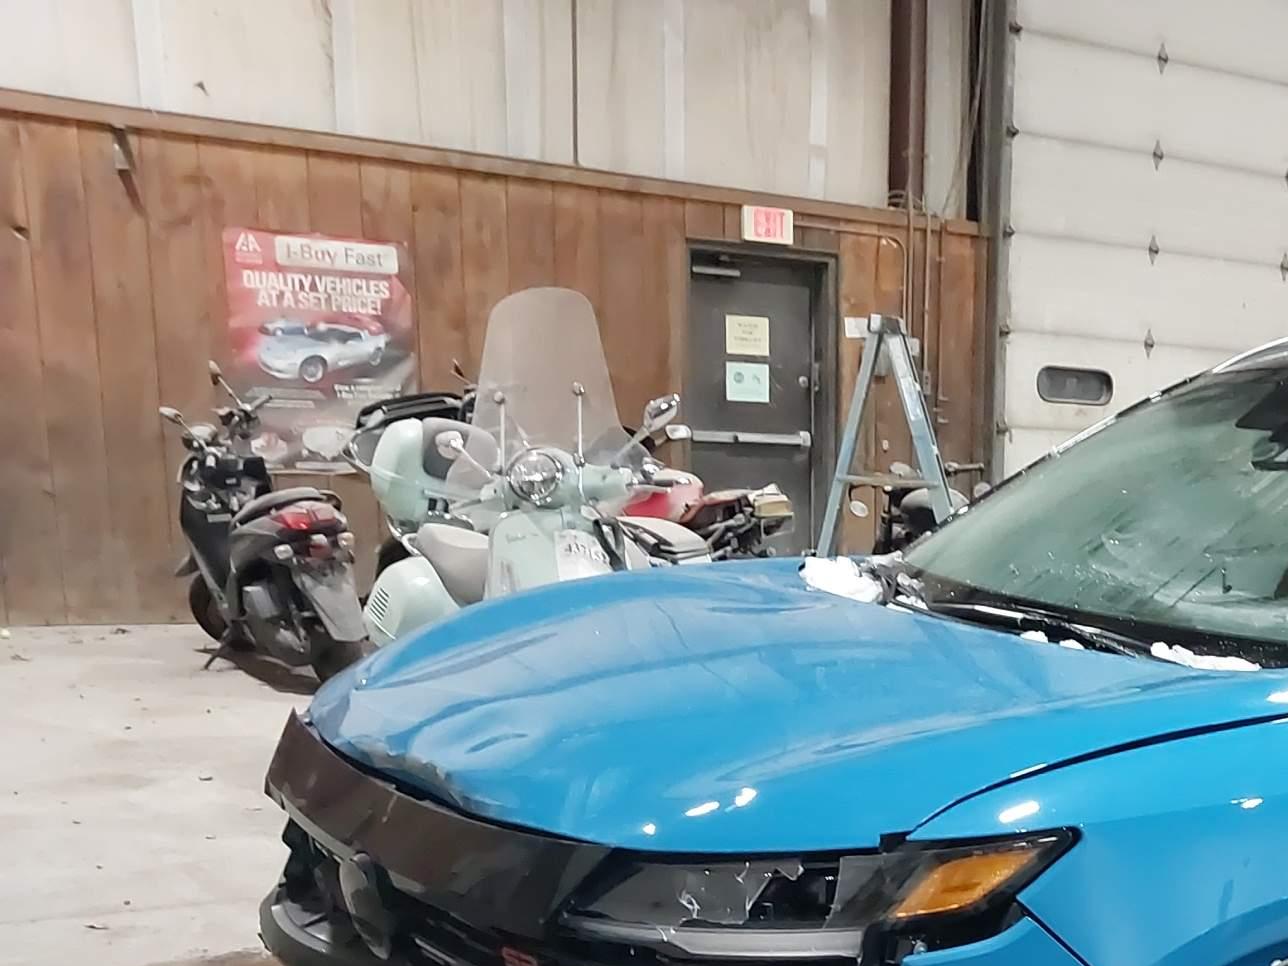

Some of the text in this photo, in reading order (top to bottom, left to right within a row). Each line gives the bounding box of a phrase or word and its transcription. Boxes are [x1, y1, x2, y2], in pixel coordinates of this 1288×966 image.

[754, 207, 785, 239] EXIT
[286, 243, 336, 264] I-Buy
[344, 247, 383, 266] Fast
[242, 269, 390, 299] QUALITY VEHICLES
[257, 289, 382, 315] AT A SET PRICE!
